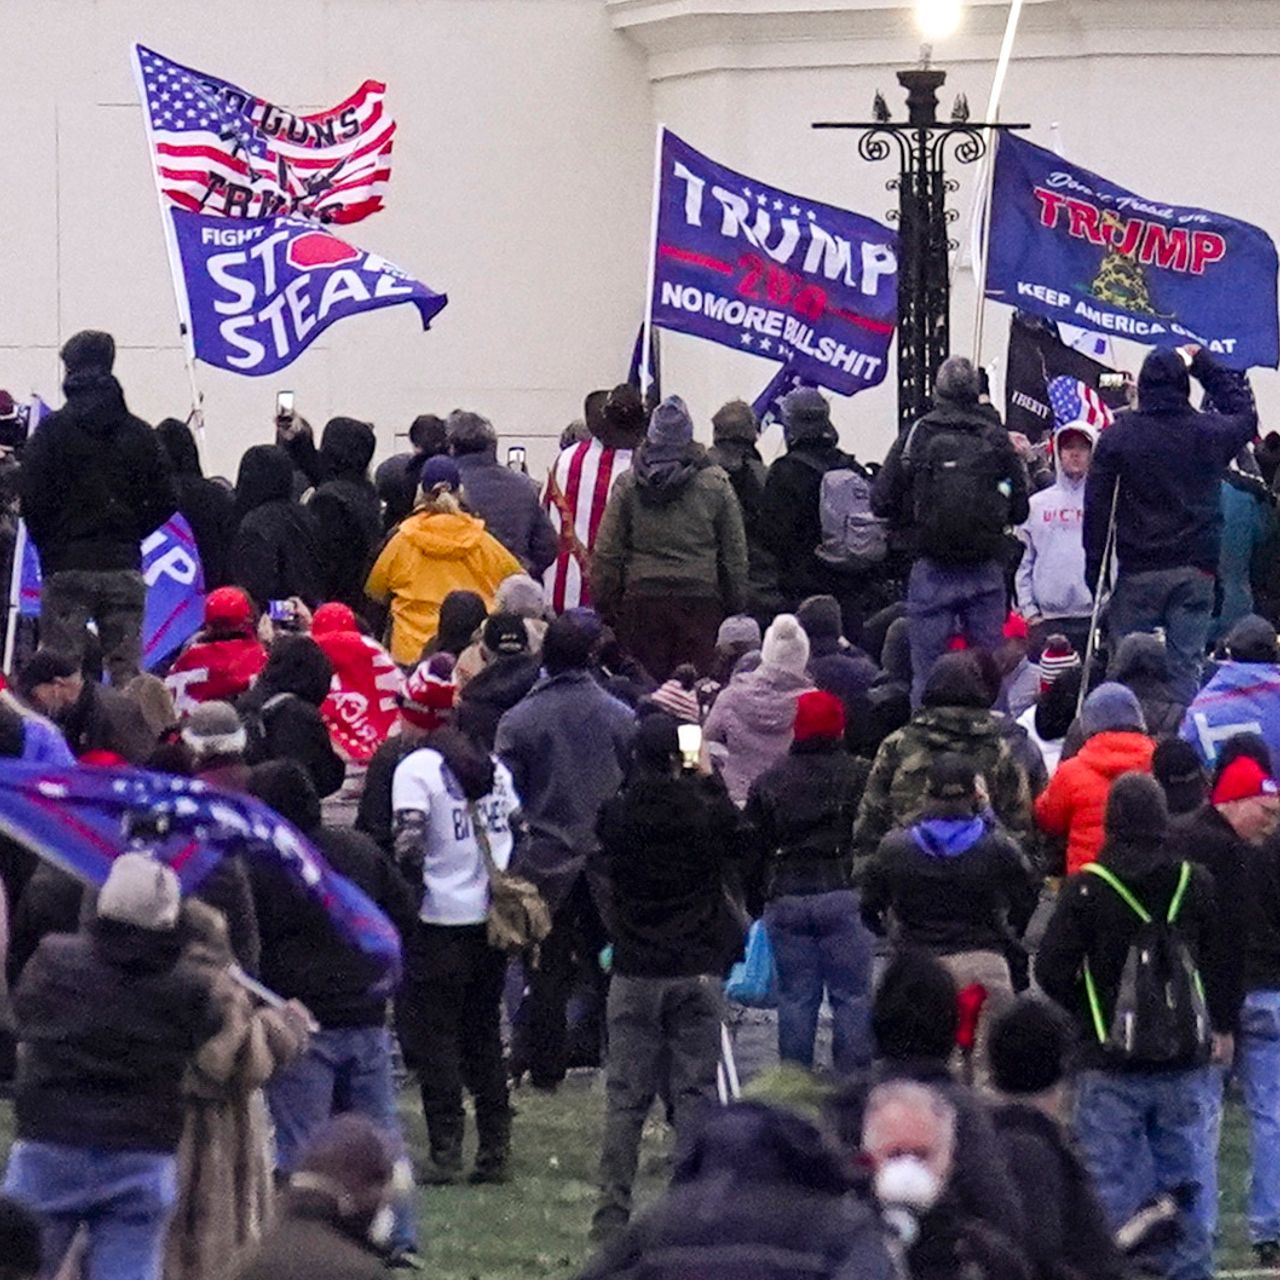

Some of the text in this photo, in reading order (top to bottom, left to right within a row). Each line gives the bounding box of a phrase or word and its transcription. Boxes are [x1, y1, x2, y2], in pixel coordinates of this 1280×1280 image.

[202, 224, 265, 246] FIGHT
[673, 161, 898, 297] TRUMP
[1032, 186, 1227, 276] TRUMP
[219, 267, 414, 368] STEAL
[1017, 281, 1070, 309] KEEP
[1074, 300, 1166, 336] AMERICA
